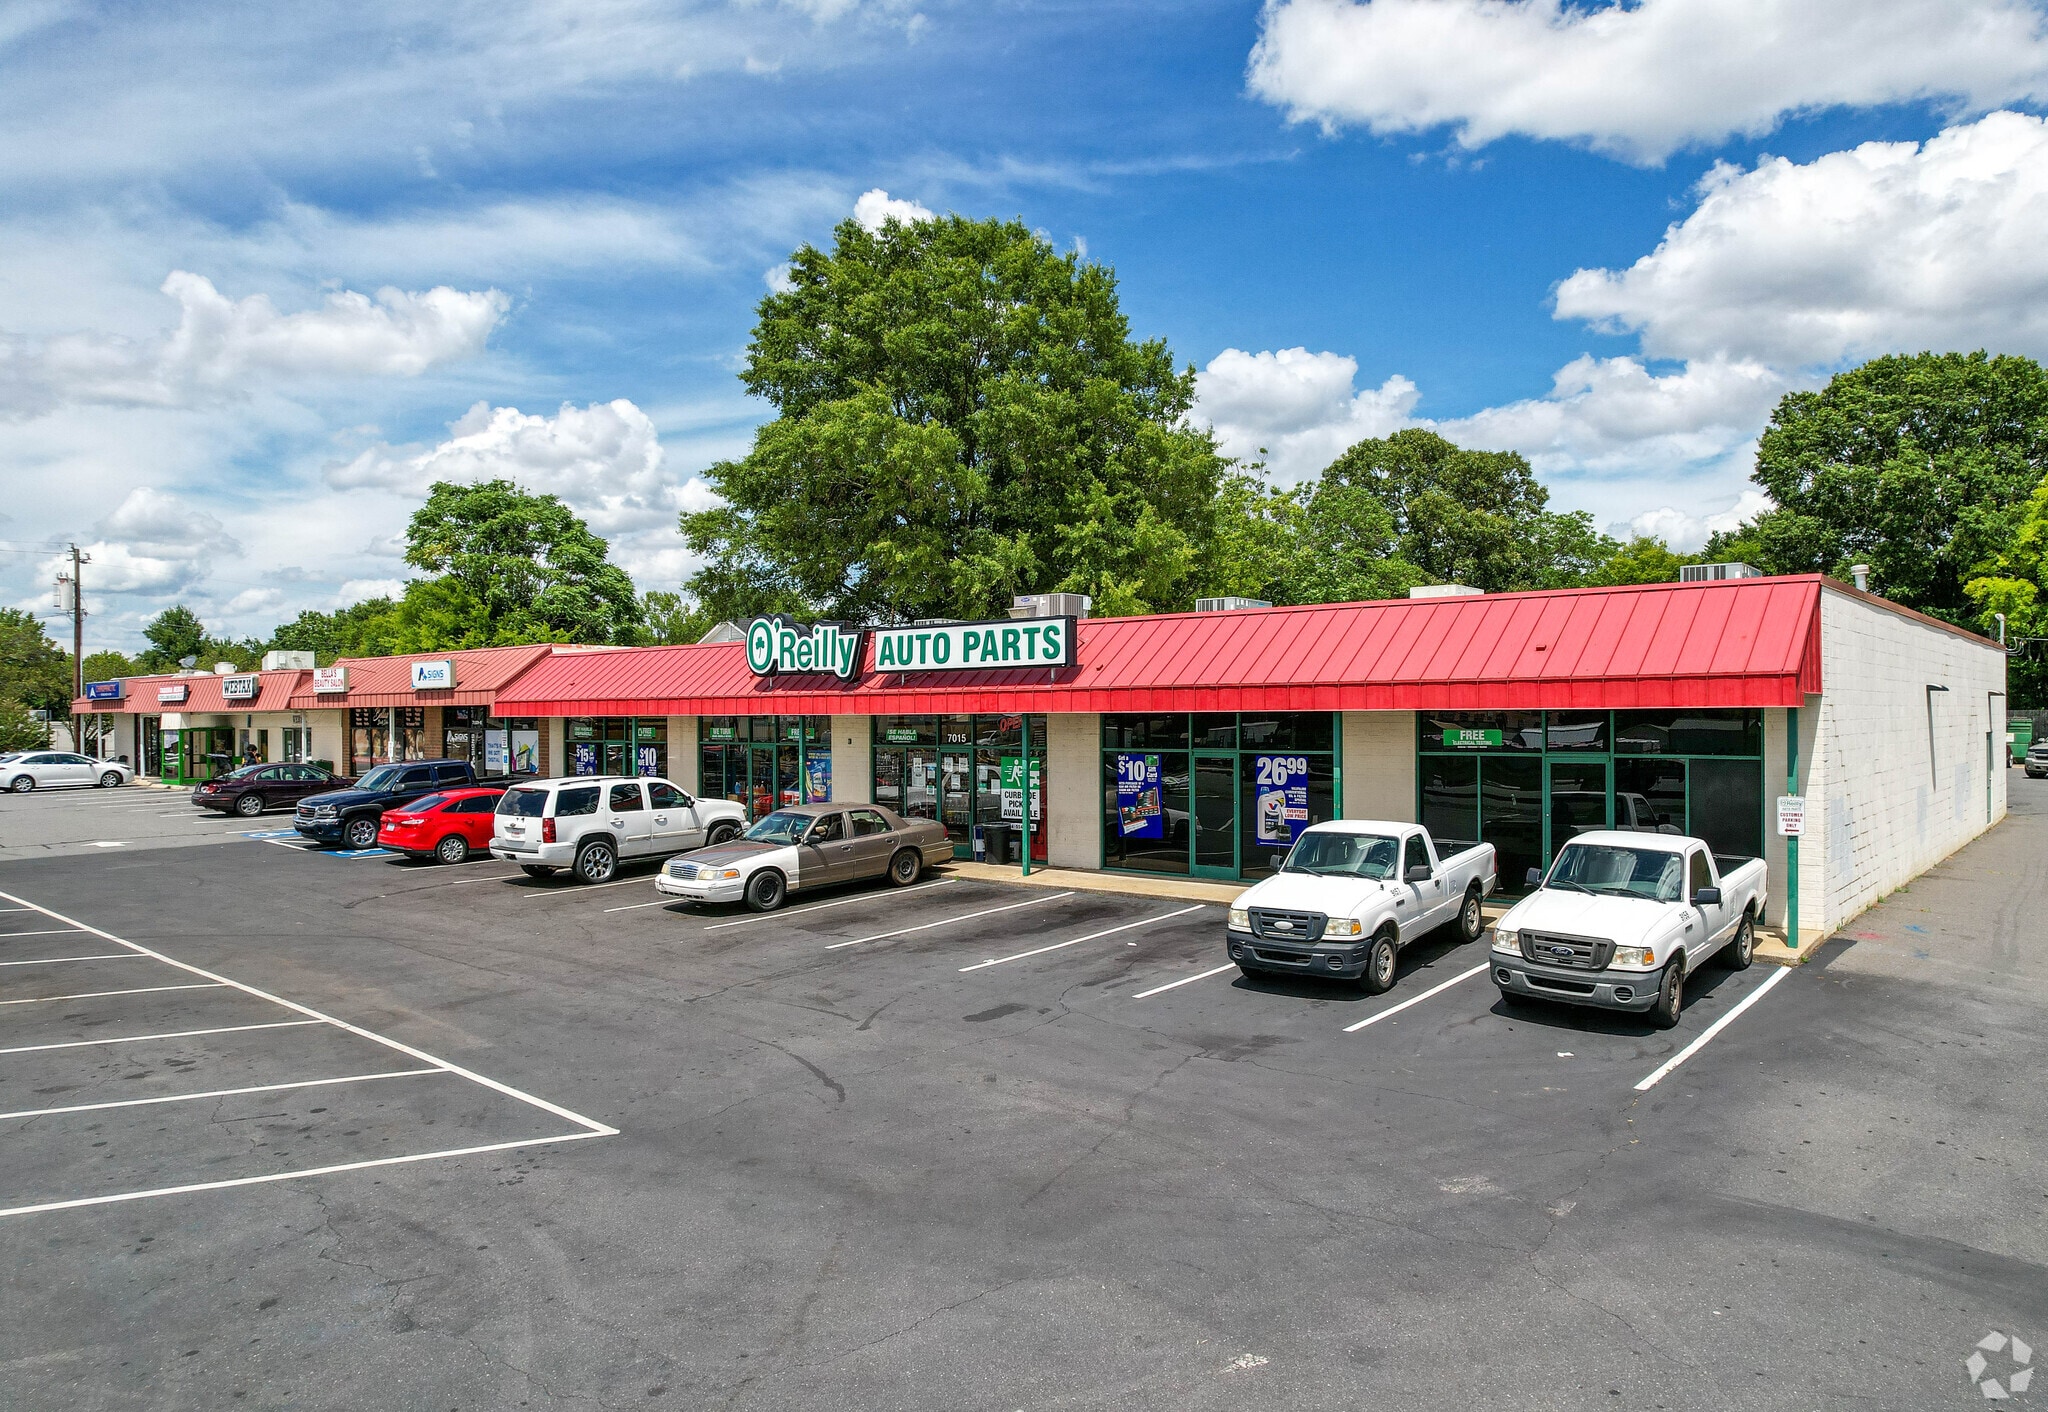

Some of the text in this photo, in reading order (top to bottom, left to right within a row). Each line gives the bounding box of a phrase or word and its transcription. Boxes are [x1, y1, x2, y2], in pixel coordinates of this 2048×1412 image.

[749, 618, 858, 674] O'Reilly
[879, 625, 1061, 666] AUTO PARTS
[320, 669, 337, 679] BELLA'S
[427, 669, 444, 679] SIGNS
[223, 680, 251, 694] WEBTAX
[314, 678, 344, 688] BEAUTY SALON
[947, 733, 966, 743] 7015
[1460, 730, 1485, 740] FREE
[576, 748, 589, 762] $15
[639, 747, 657, 767] $10
[1118, 760, 1145, 781] $10
[1004, 791, 1037, 800] CURBDE
[1008, 800, 1032, 808] PICKP
[1003, 809, 1038, 818] AVAILLE
